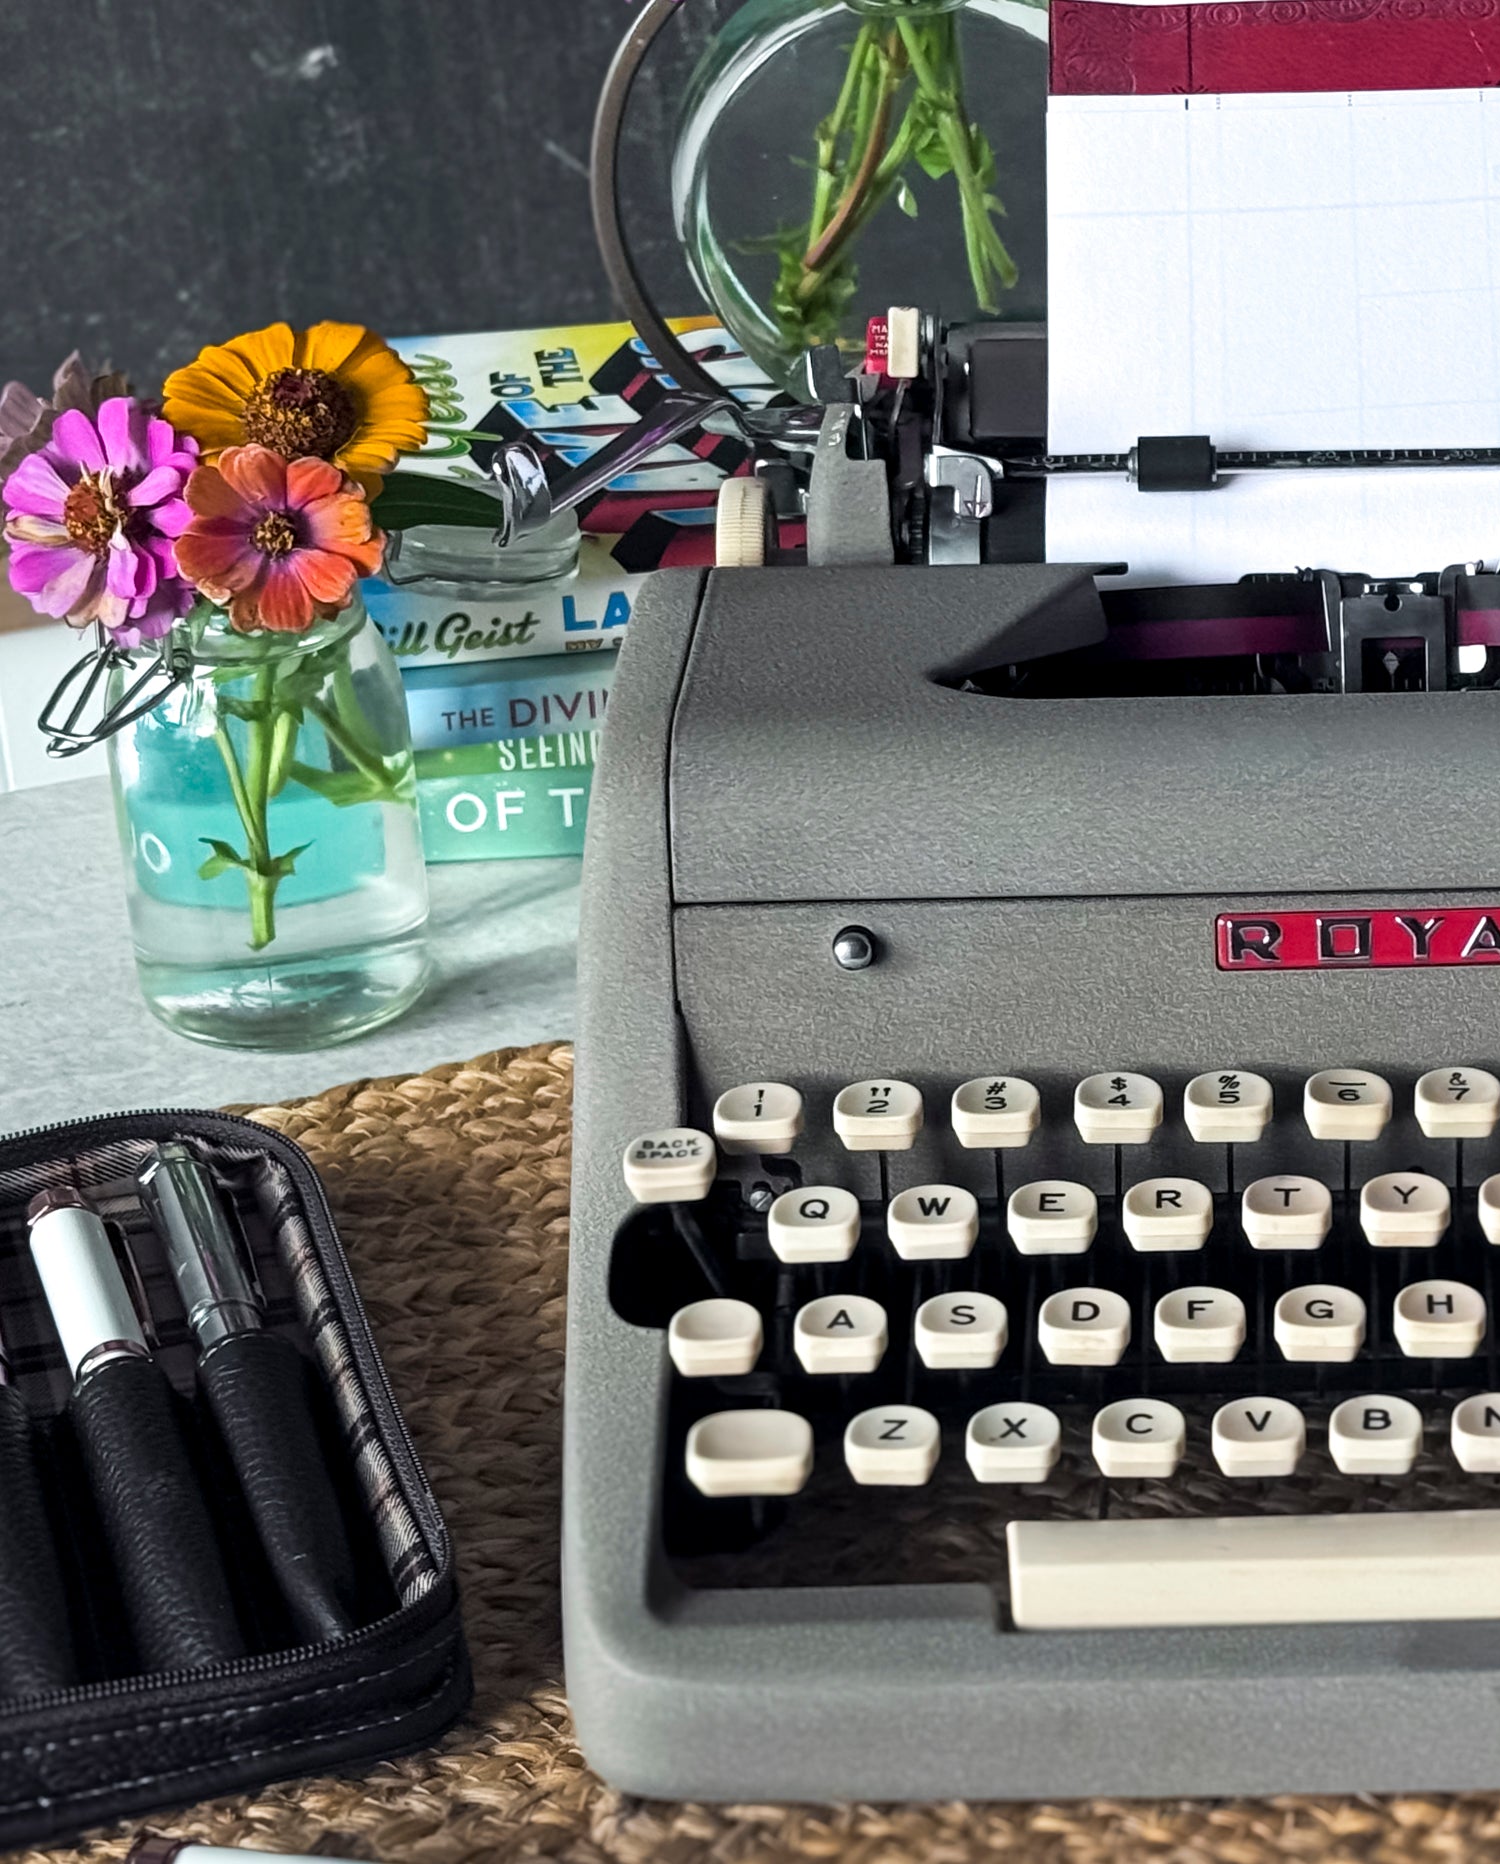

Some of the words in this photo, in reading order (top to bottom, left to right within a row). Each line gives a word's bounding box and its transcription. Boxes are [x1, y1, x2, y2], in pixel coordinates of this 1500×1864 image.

[534, 346, 583, 388] THE
[489, 370, 535, 397] OF
[435, 611, 541, 659] Geist
[441, 707, 495, 731] THE
[509, 688, 608, 728] DIVI
[446, 786, 526, 832] OF
[985, 1081, 1007, 1096] #
[1110, 1076, 1128, 1092] $
[1217, 1074, 1241, 1090] %
[1448, 1071, 1467, 1087] &
[758, 1089, 765, 1103] !
[984, 1096, 1008, 1111] 3
[1107, 1093, 1131, 1107] 4
[1217, 1090, 1241, 1104] 5
[1336, 1088, 1361, 1102] 6
[1447, 1087, 1470, 1101] 7
[753, 1103, 763, 1117] 1
[865, 1099, 890, 1114] 2
[634, 1147, 702, 1159] SPACE
[642, 1139, 698, 1149] BACK
[1038, 1192, 1066, 1213] E
[1155, 1189, 1182, 1209] R
[1273, 1187, 1301, 1208] T
[1392, 1185, 1419, 1205] Y
[798, 1198, 830, 1220] Q
[916, 1196, 951, 1217] W
[1071, 1300, 1101, 1322] D
[1187, 1299, 1214, 1321] F
[1304, 1299, 1334, 1320] G
[1426, 1293, 1454, 1315] H
[826, 1309, 855, 1330] A
[949, 1305, 977, 1326] S
[878, 1419, 908, 1441] Z
[999, 1417, 1027, 1440] X
[1125, 1413, 1153, 1435] C
[1244, 1410, 1272, 1433] V
[1362, 1408, 1392, 1431] B
